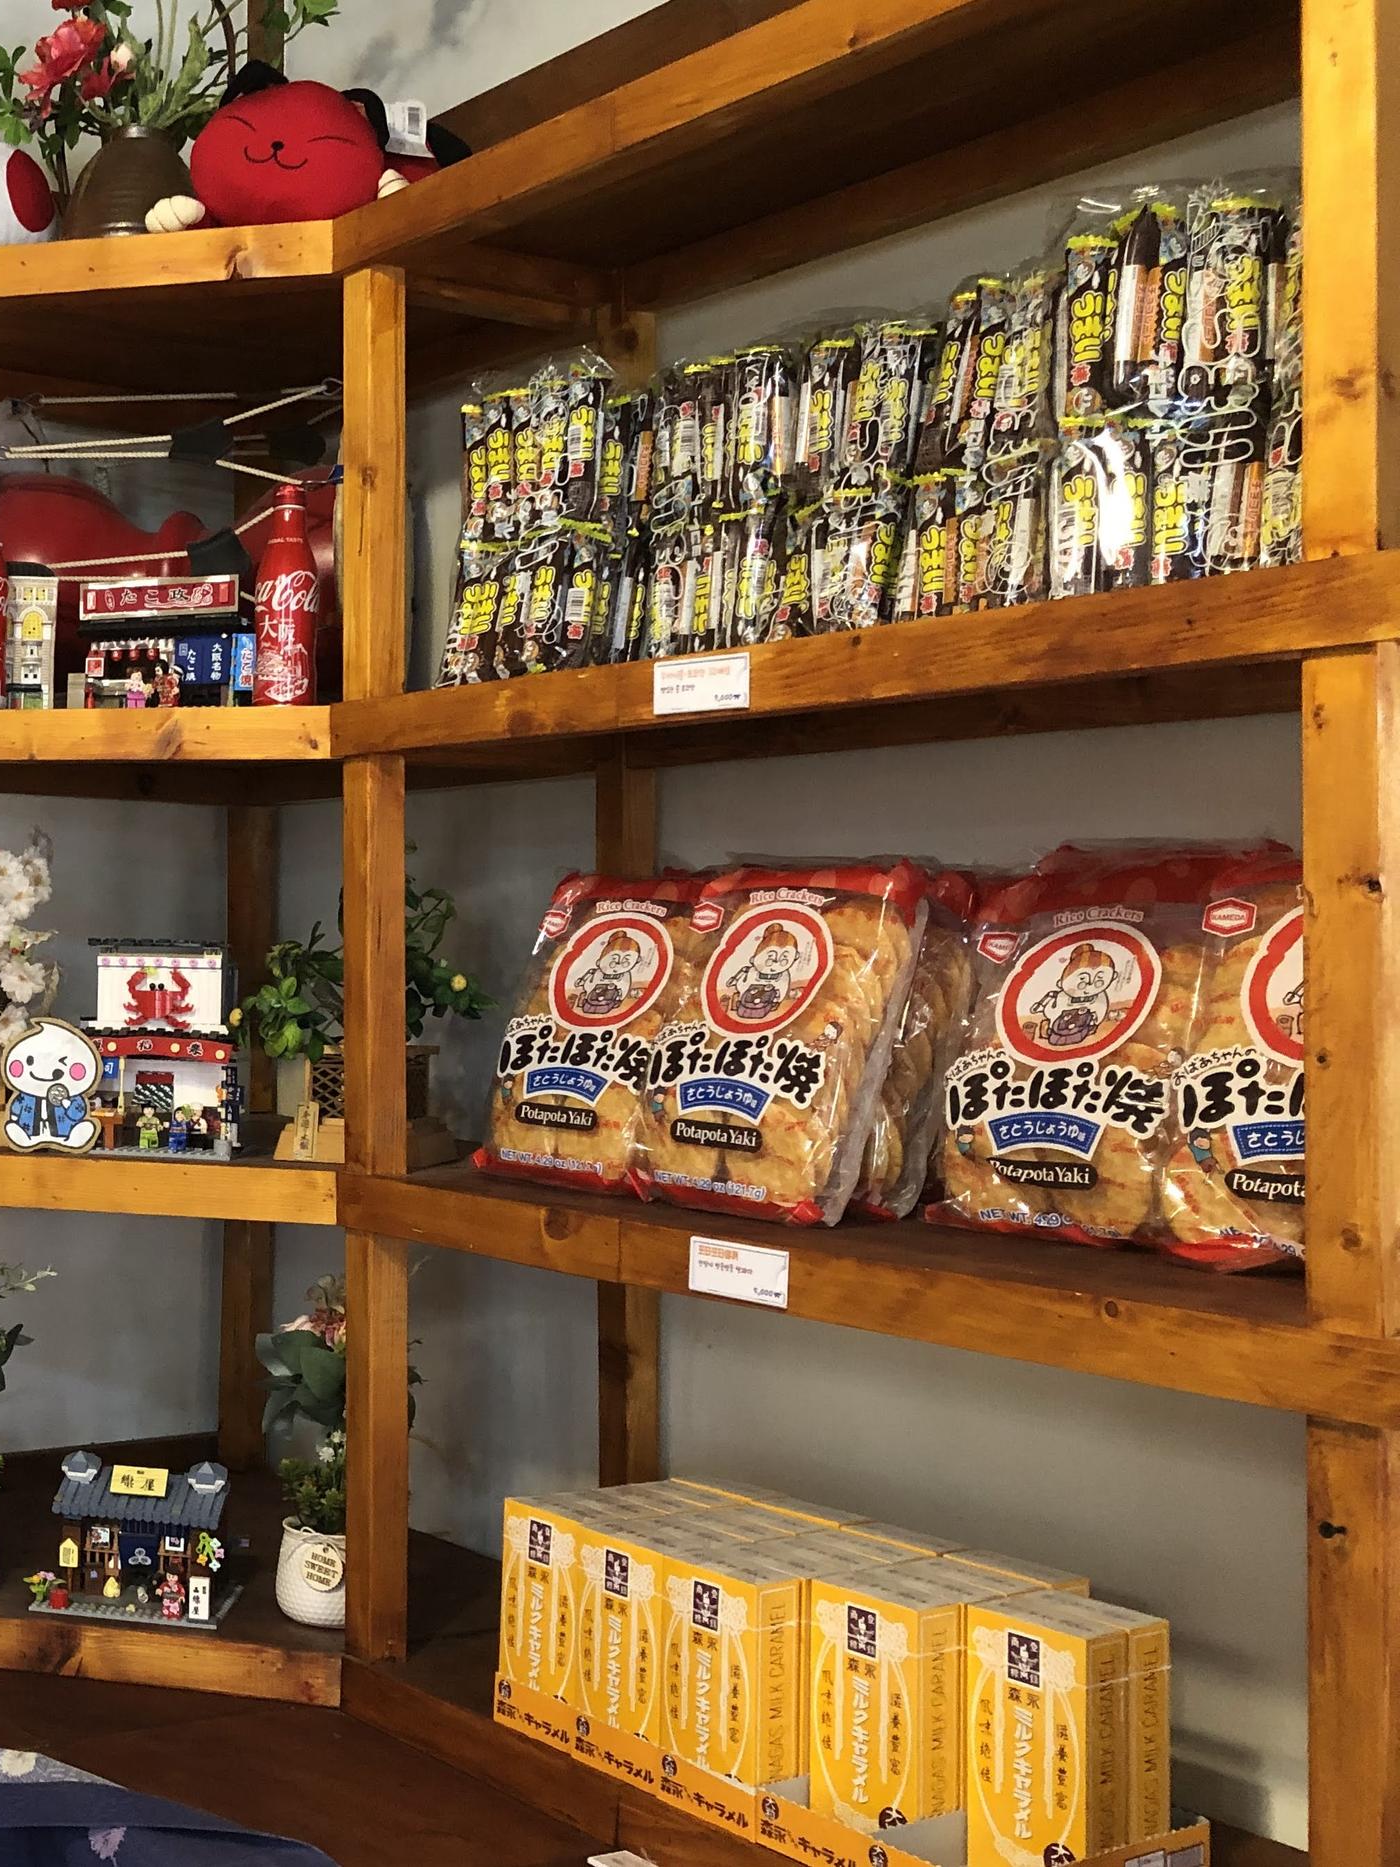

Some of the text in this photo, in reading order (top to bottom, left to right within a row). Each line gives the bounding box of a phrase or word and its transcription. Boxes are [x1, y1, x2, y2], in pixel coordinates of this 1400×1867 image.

[499, 1025, 649, 1092] ぽたぽた焼
[650, 1032, 823, 1104] ぽたぽた焼
[950, 1061, 1165, 1134] ぽたぽた焼
[519, 1105, 593, 1127] Potapota Yaki
[676, 1121, 758, 1147] Potapota Yaki
[501, 1150, 517, 1161] NET
[654, 1171, 673, 1184] NET
[1055, 1166, 1091, 1185] Yaki
[304, 1560, 339, 1579] SWEET
